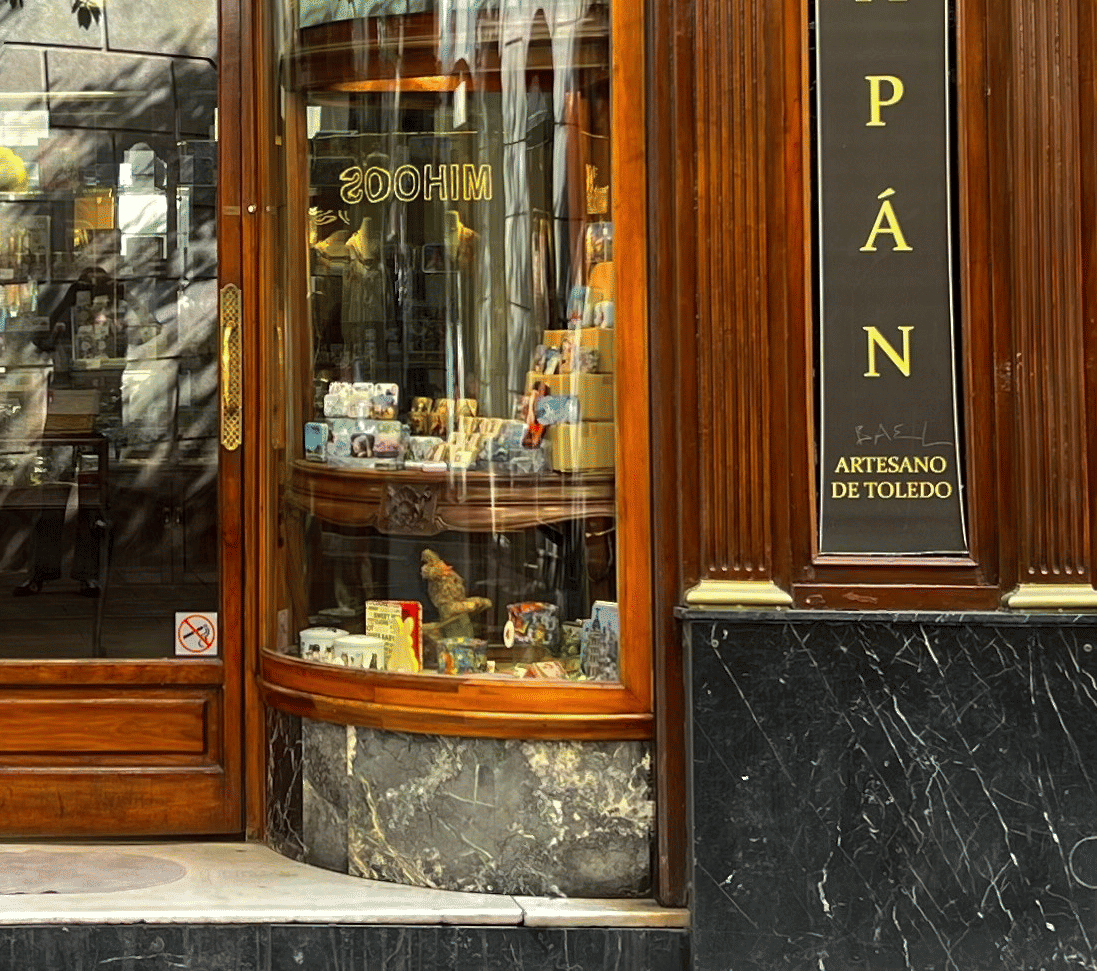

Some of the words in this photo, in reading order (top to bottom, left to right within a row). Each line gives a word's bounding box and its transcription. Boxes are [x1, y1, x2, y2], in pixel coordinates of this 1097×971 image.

[834, 455, 947, 474] ARTESANO
[831, 481, 860, 499] DE
[863, 480, 953, 500] TOLEDO
